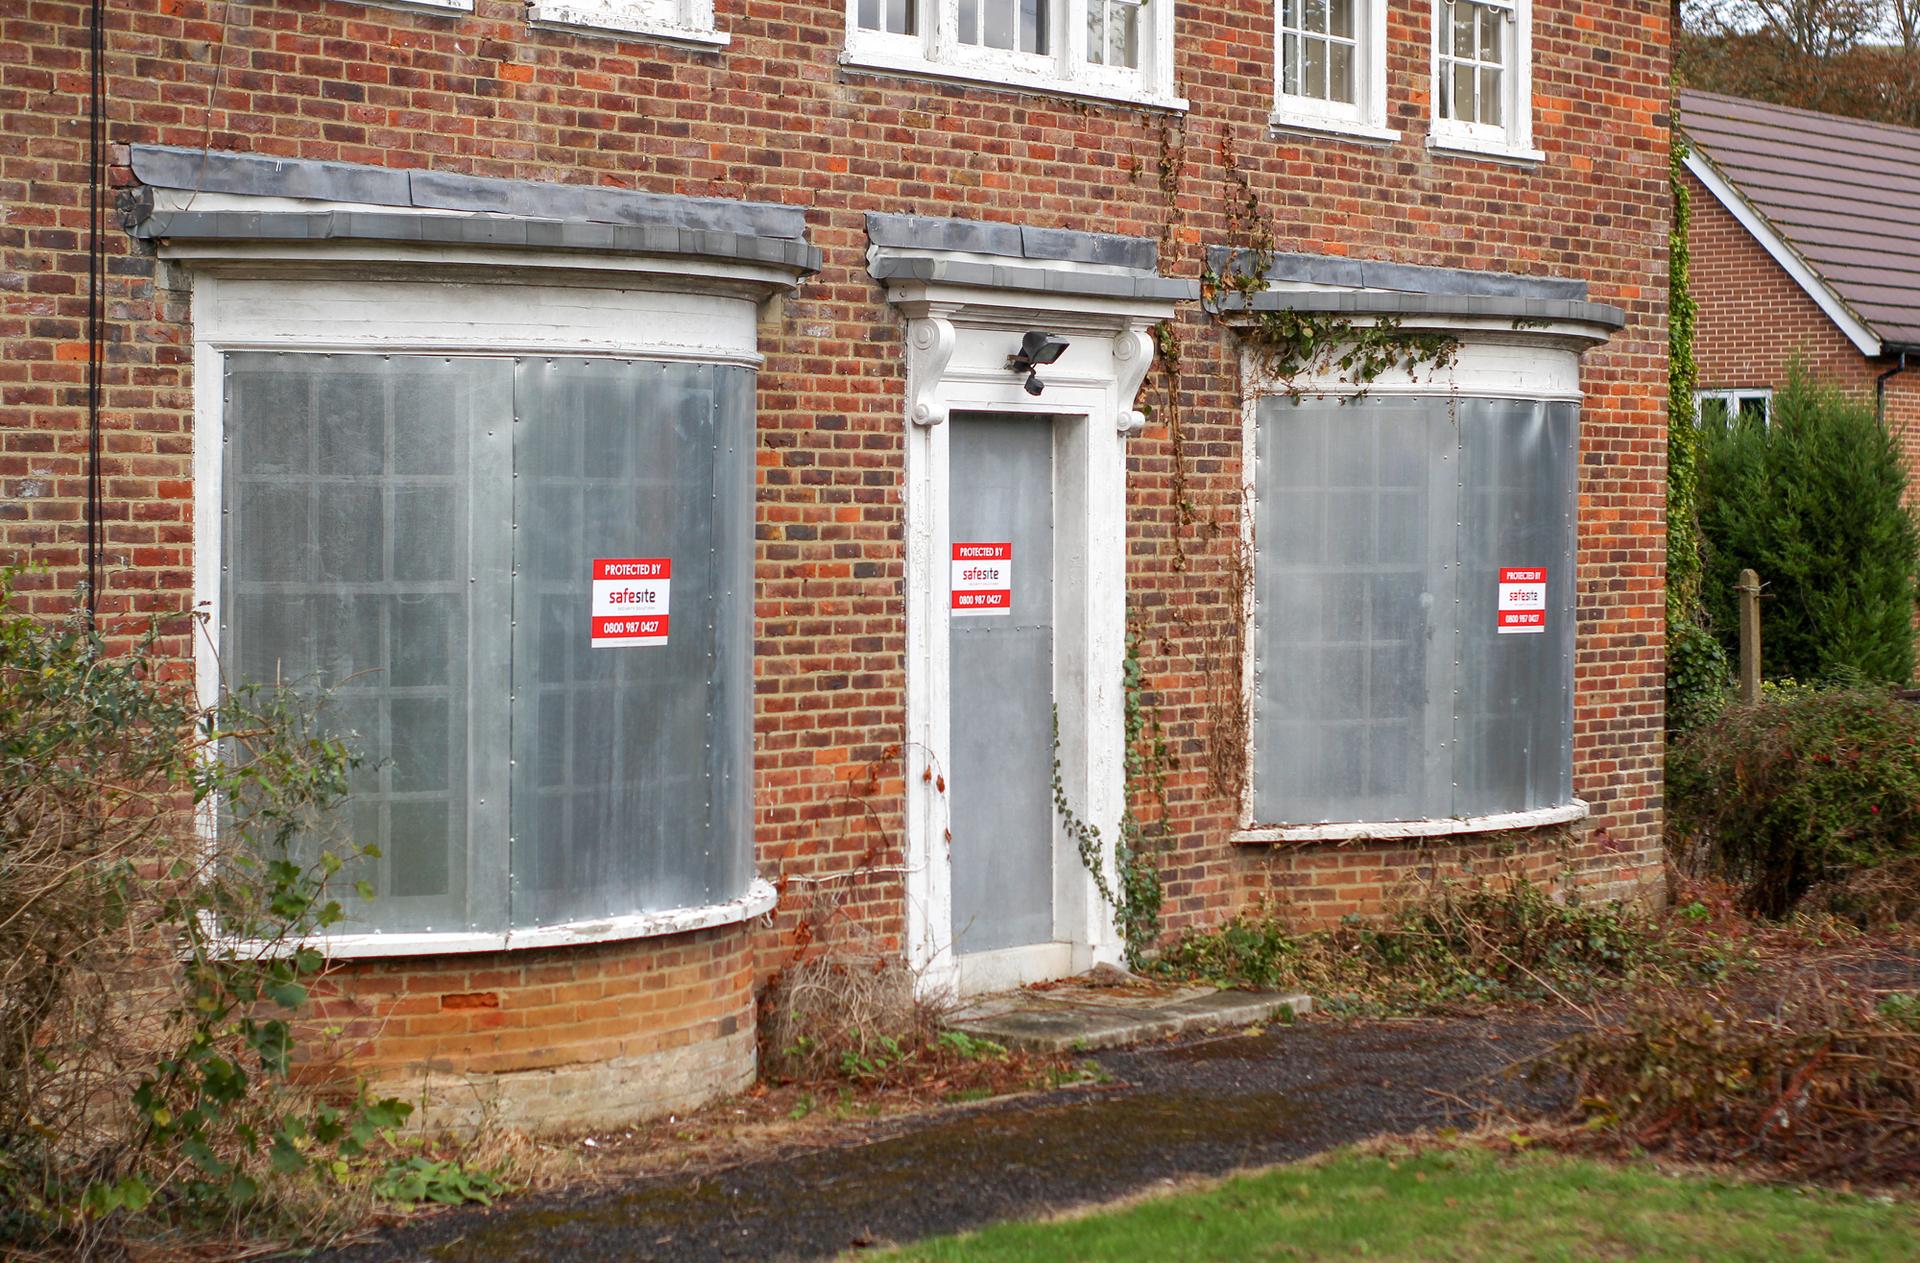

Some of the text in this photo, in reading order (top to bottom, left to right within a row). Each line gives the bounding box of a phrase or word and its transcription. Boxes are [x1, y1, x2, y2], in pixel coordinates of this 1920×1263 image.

[960, 547, 1003, 557] PROTECTED BY
[605, 564, 661, 575] PROTECTED BY
[963, 566, 999, 580] safesite
[609, 587, 656, 603] safesite
[1509, 588, 1538, 601] safesite
[603, 621, 659, 633] 0800 987 0427
